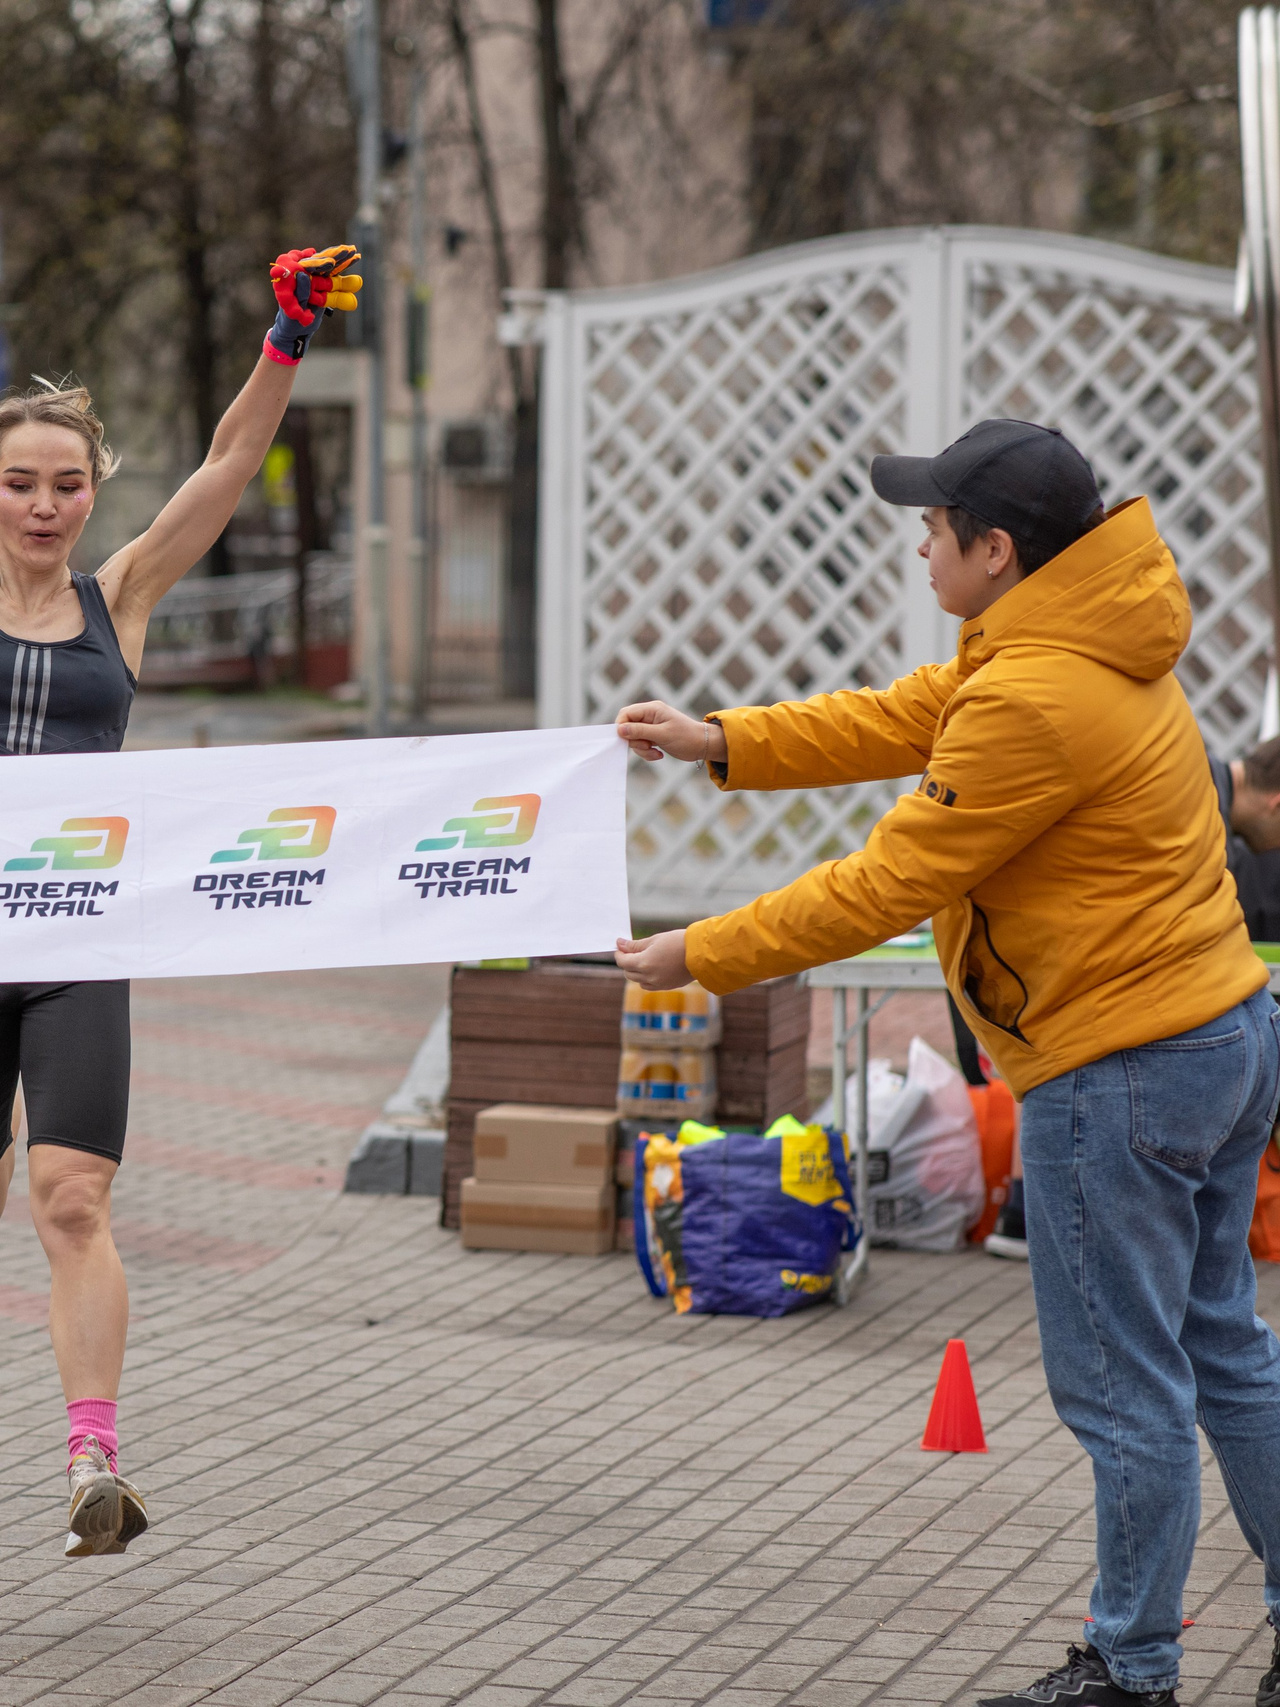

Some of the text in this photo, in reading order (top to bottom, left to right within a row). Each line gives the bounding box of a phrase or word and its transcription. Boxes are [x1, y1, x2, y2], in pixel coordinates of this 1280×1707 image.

[398, 857, 531, 880] DREAM
[193, 869, 326, 892] DREAM
[414, 877, 517, 899] TRAIL
[3, 900, 104, 918] TRAIL
[209, 889, 312, 910] TRAIL
